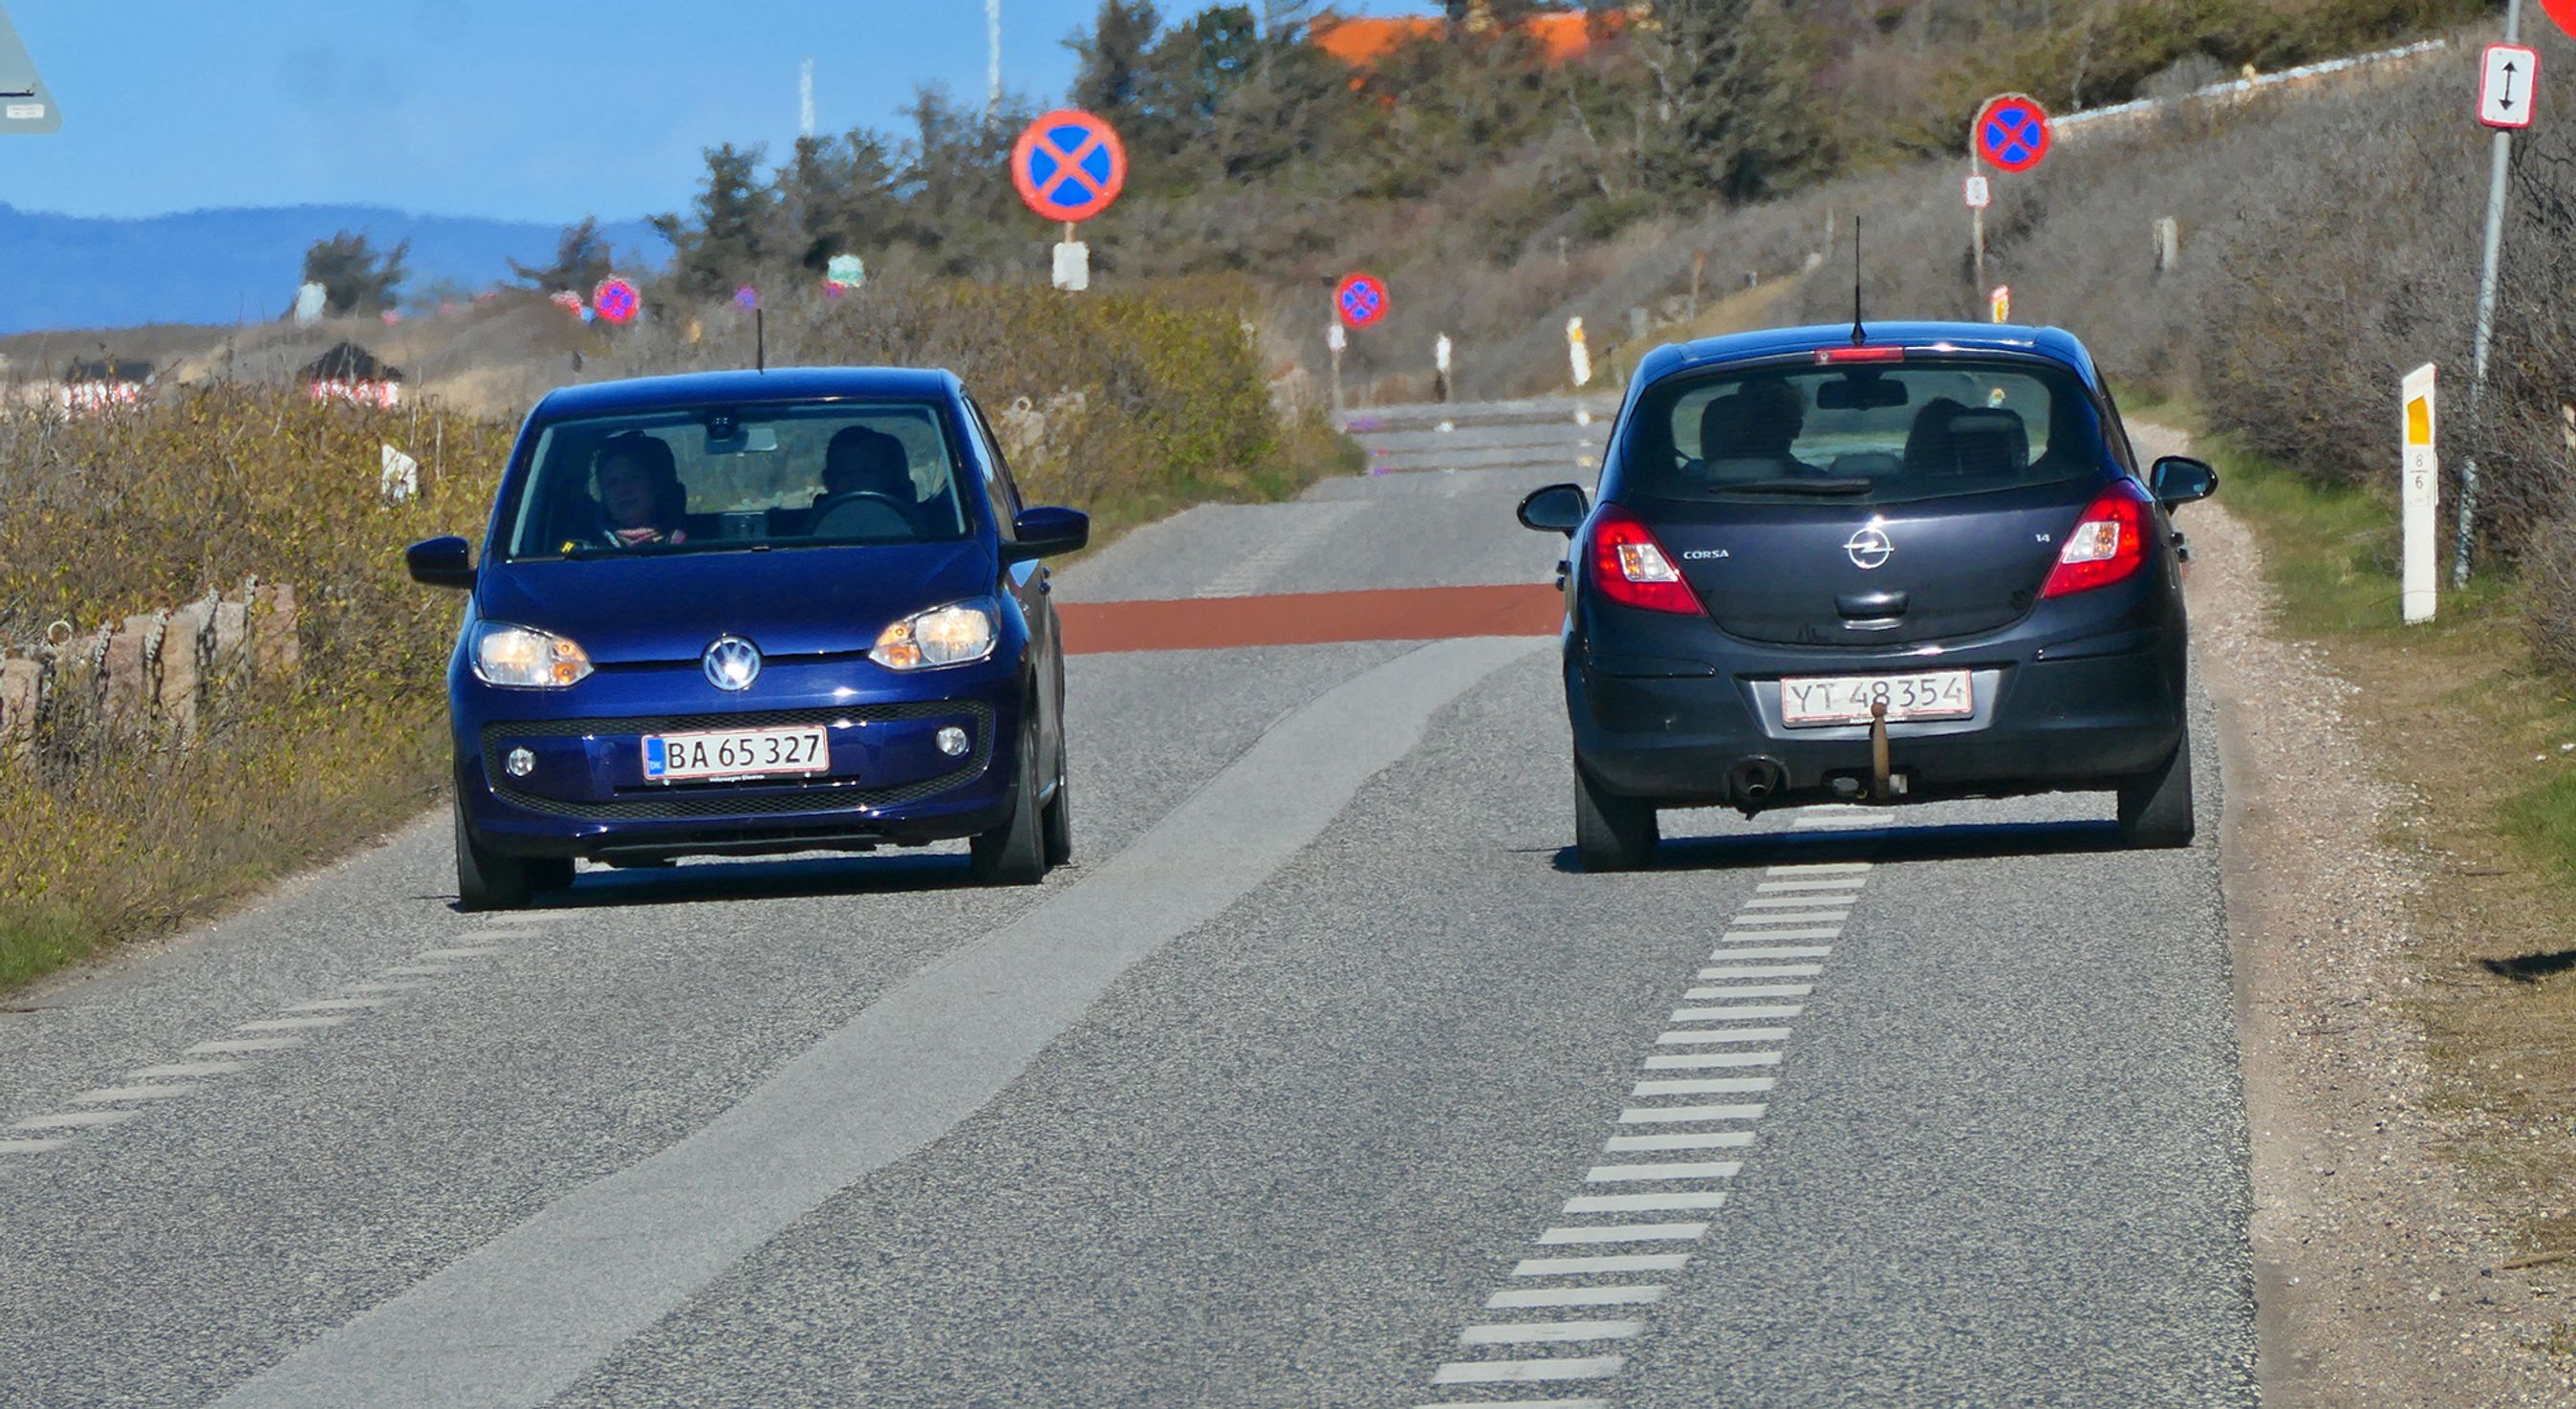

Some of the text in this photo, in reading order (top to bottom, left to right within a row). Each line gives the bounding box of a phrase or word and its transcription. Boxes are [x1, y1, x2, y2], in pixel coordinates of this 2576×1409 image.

[2415, 453, 2423, 467] 8
[2415, 475, 2424, 489] 6
[1683, 549, 1729, 559] CORSA
[1790, 683, 1835, 712] YT
[1897, 677, 1962, 708] 354
[668, 734, 820, 770] BA 65 327
